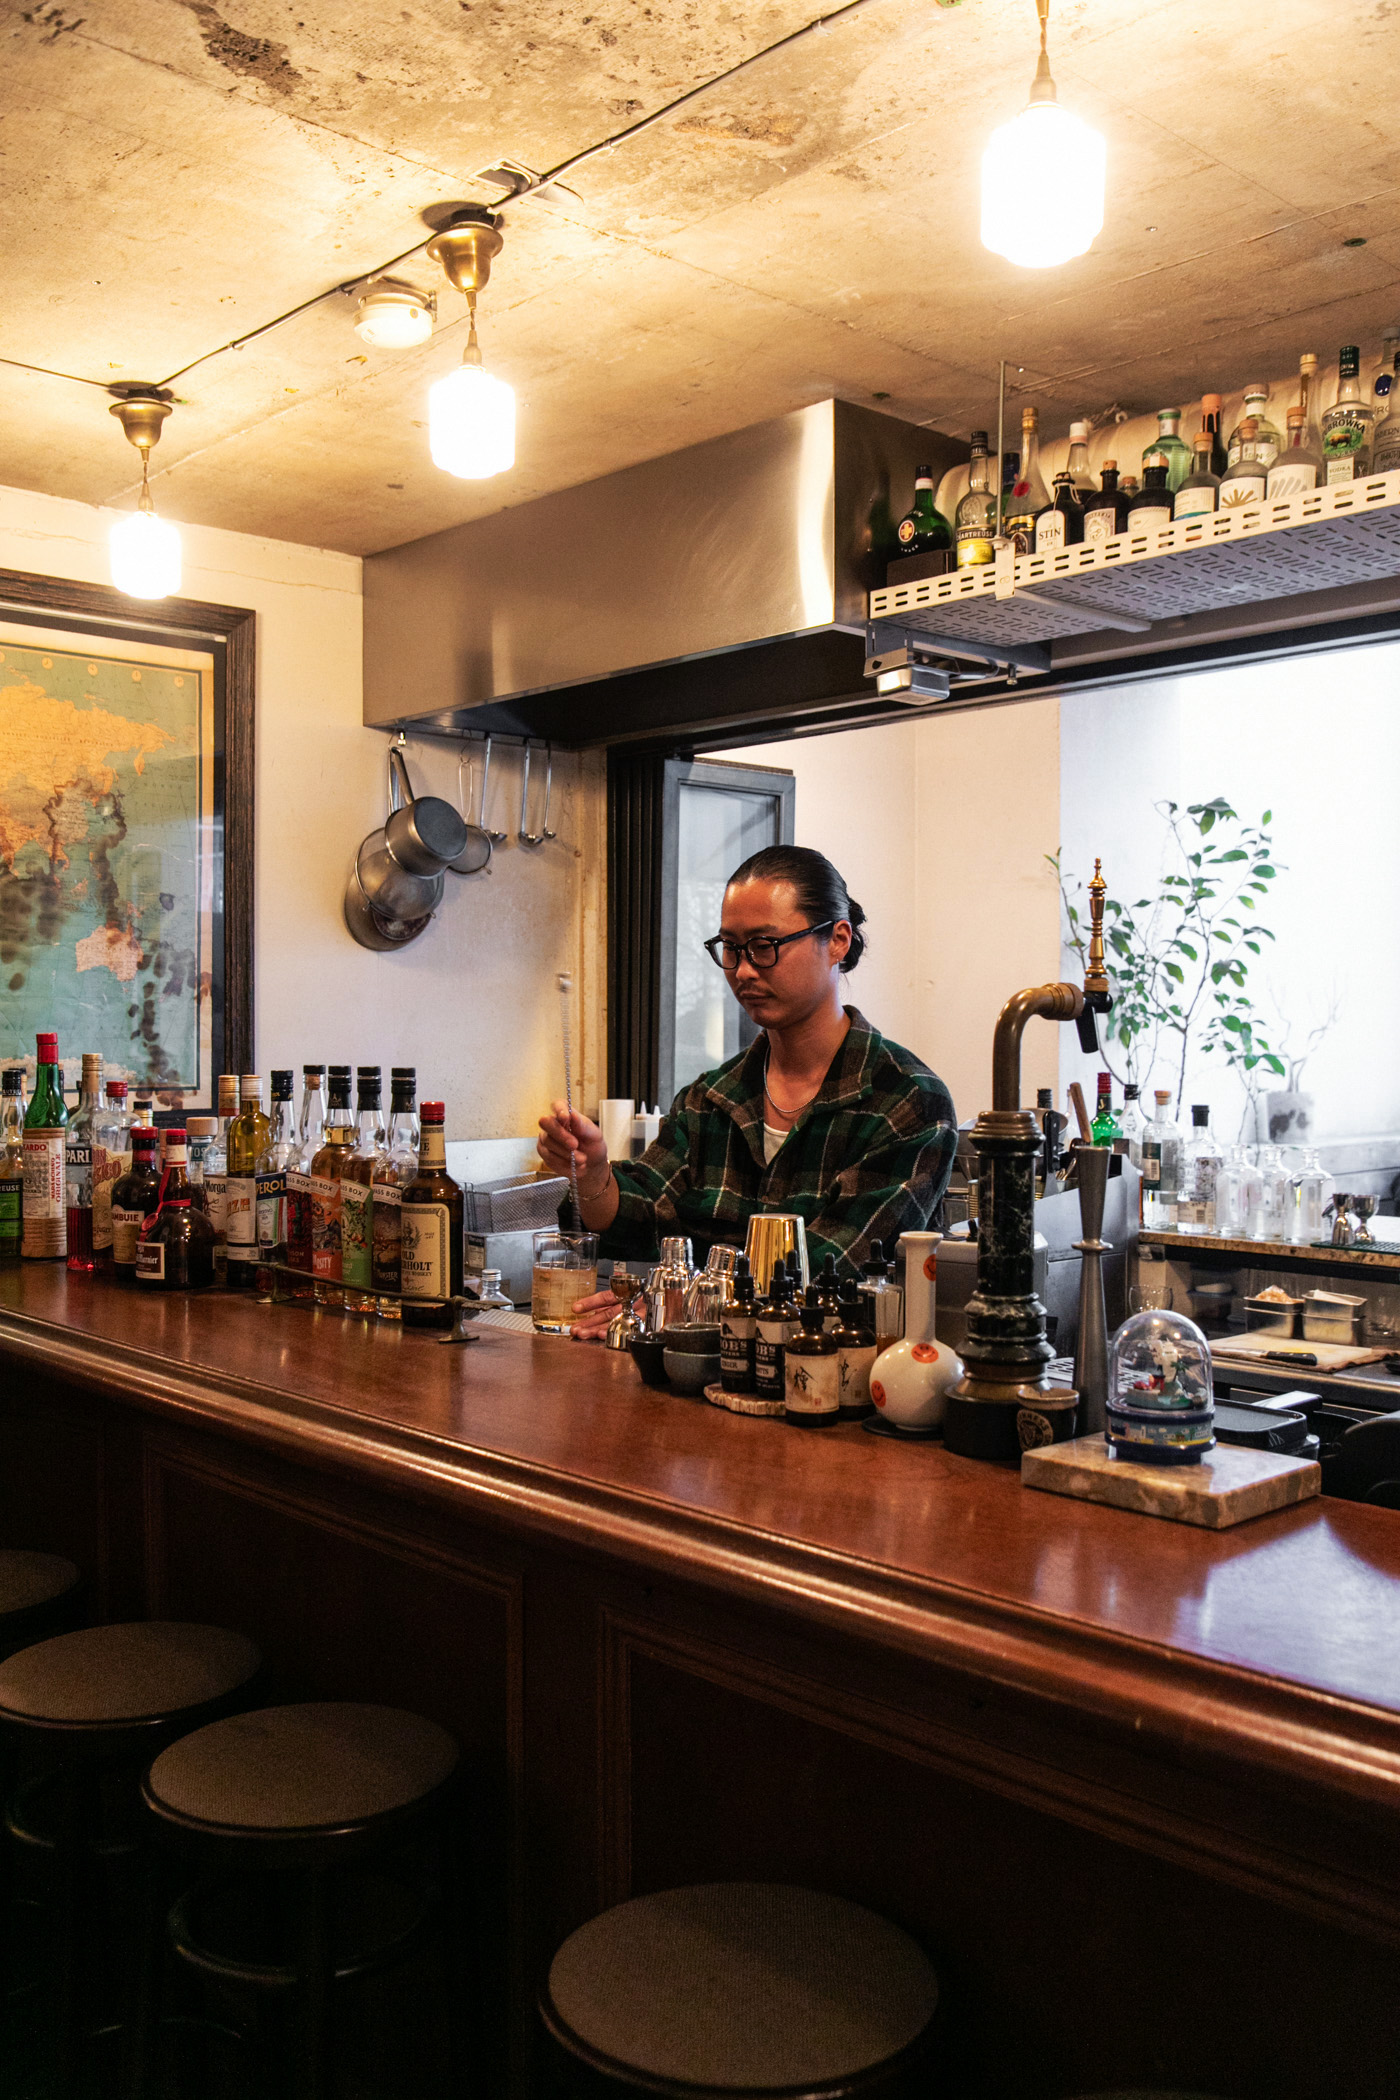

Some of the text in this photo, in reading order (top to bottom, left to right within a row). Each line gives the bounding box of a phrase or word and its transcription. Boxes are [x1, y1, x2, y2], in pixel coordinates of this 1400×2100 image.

[296, 1179, 311, 1189] BOX
[319, 1183, 334, 1193] BOX
[349, 1186, 363, 1198] BOX
